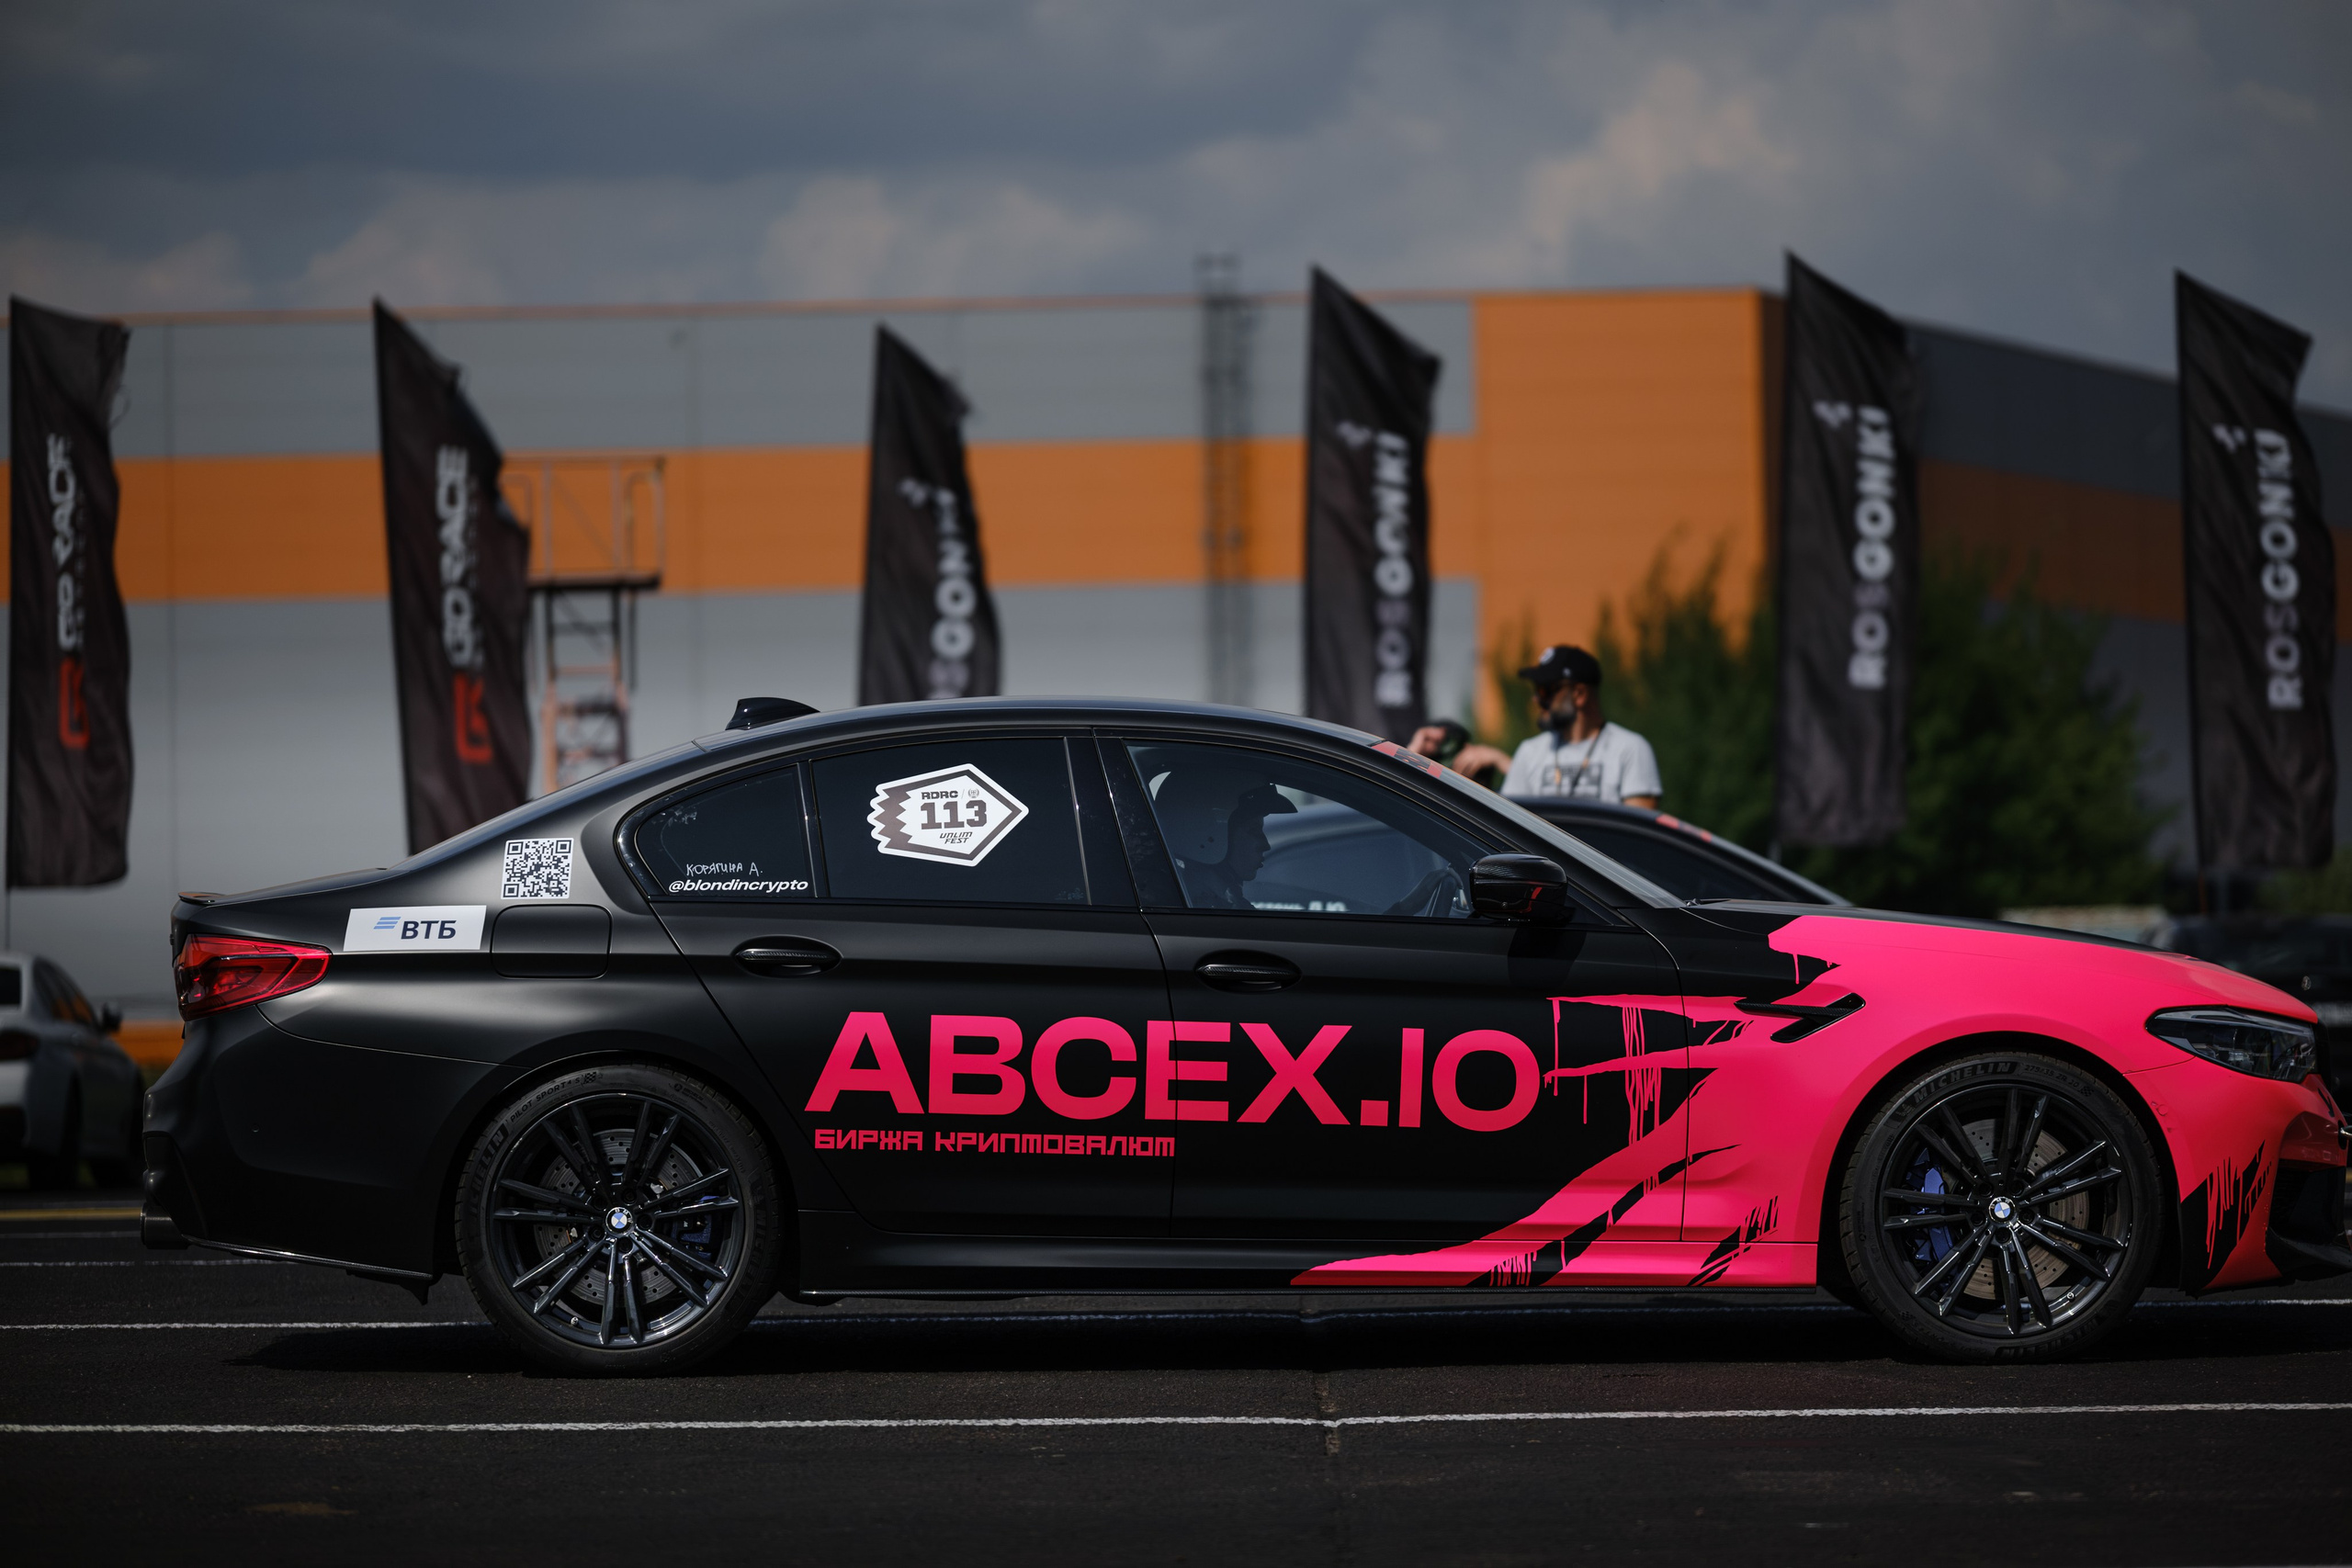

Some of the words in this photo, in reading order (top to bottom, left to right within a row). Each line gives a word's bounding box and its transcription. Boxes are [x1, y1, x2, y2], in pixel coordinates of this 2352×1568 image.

[1848, 404, 1896, 688] ROSGONKI
[2254, 427, 2303, 711] ROSGONKI
[921, 791, 958, 800] RDRC
[921, 799, 987, 829] 113
[668, 878, 809, 893] @blondincrypto
[401, 919, 457, 940] ВТБ
[803, 1011, 1541, 1133] ABCEX.IO
[1914, 1061, 2011, 1104] MICHELIN
[510, 1100, 533, 1122] PILOT
[536, 1081, 566, 1102] SPORT
[814, 1128, 923, 1151] БИРЖА
[934, 1131, 1176, 1157] КРИПТОВАЛЮТ
